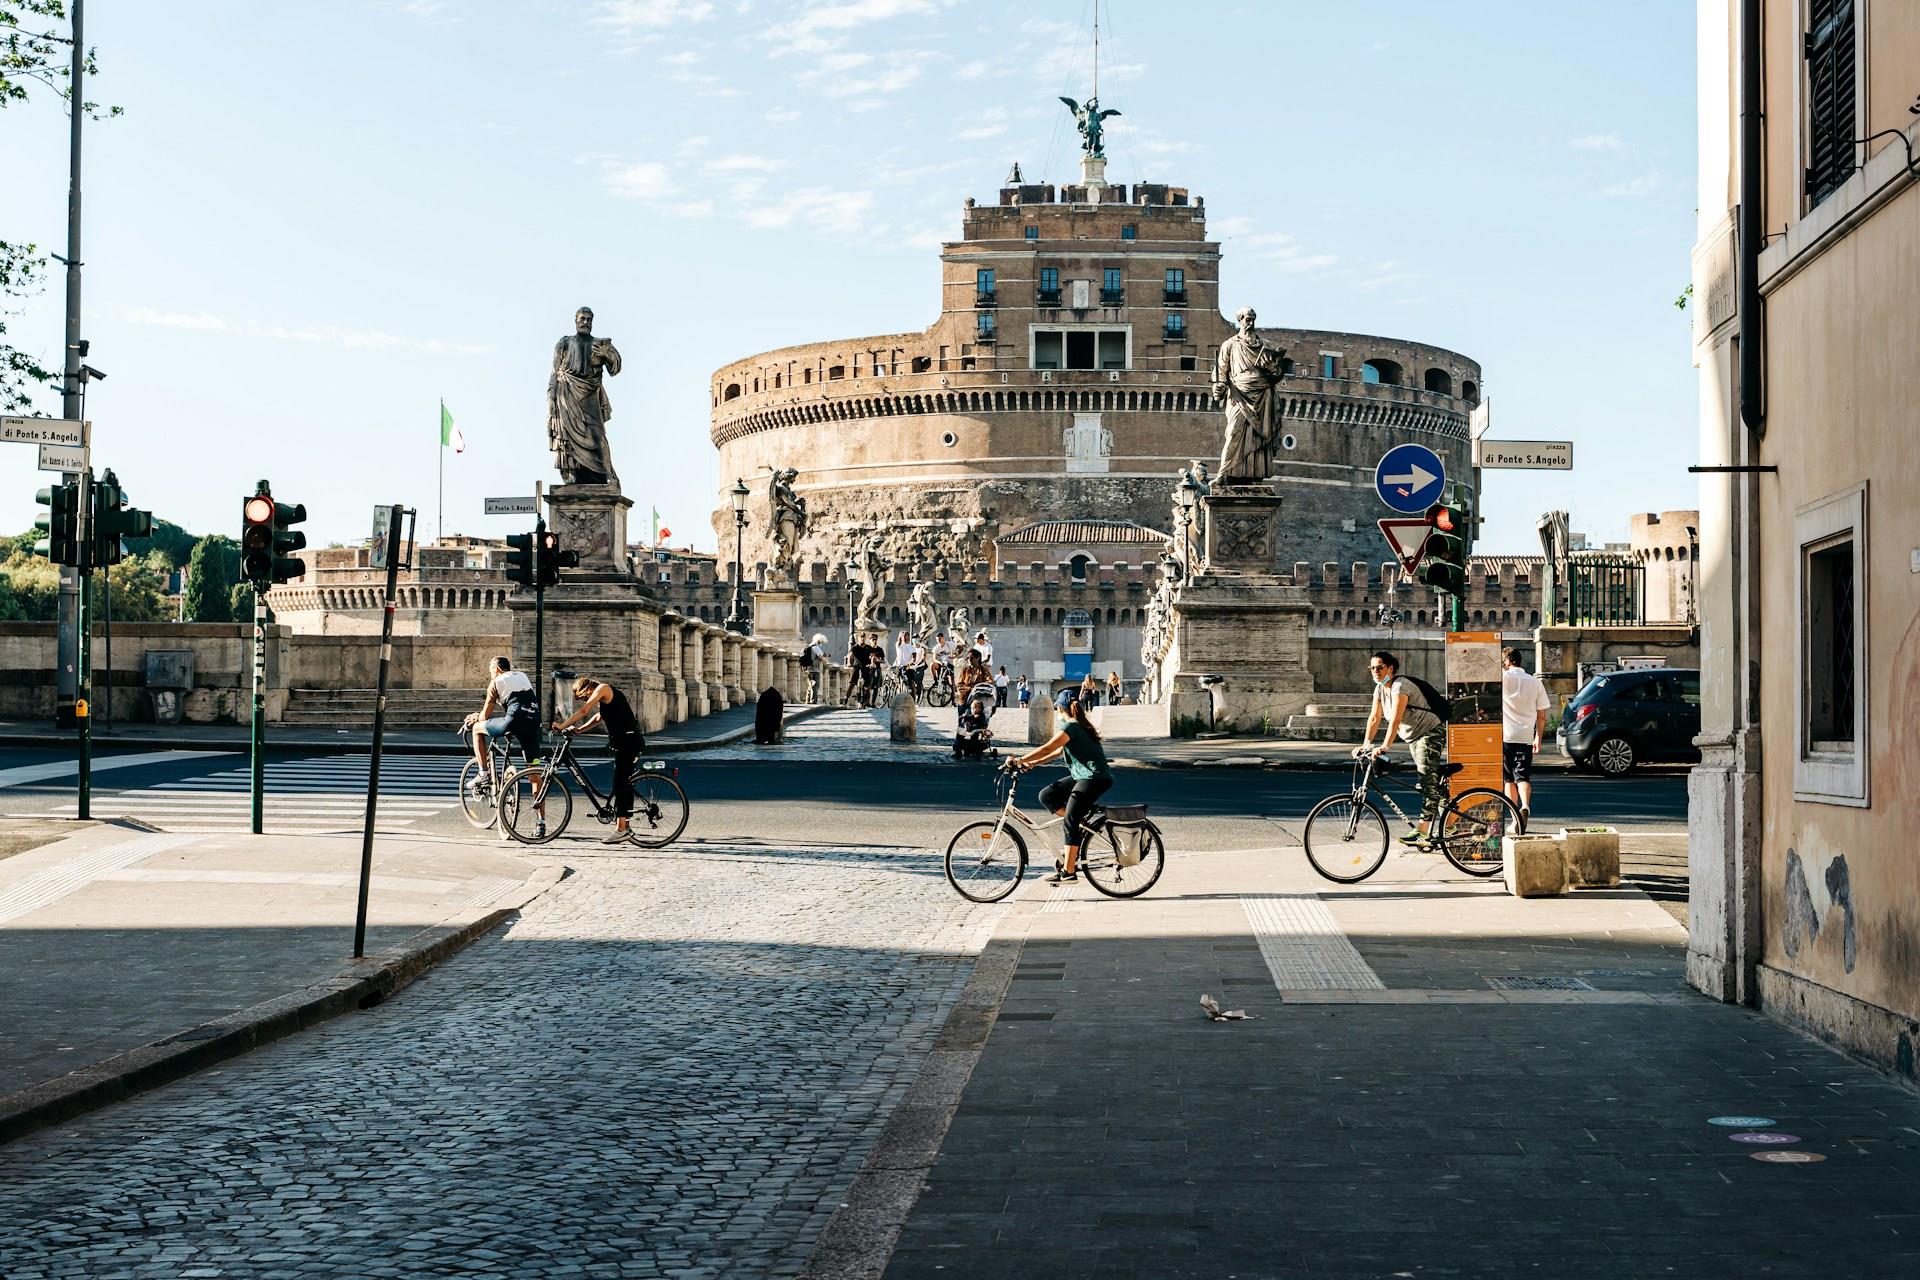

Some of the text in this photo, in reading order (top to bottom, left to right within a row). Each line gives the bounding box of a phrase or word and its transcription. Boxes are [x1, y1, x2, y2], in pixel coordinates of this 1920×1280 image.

[5, 428, 13, 437] di
[16, 429, 39, 439] Ponte
[1485, 454, 1494, 463] di
[1498, 454, 1523, 464] Ponte
